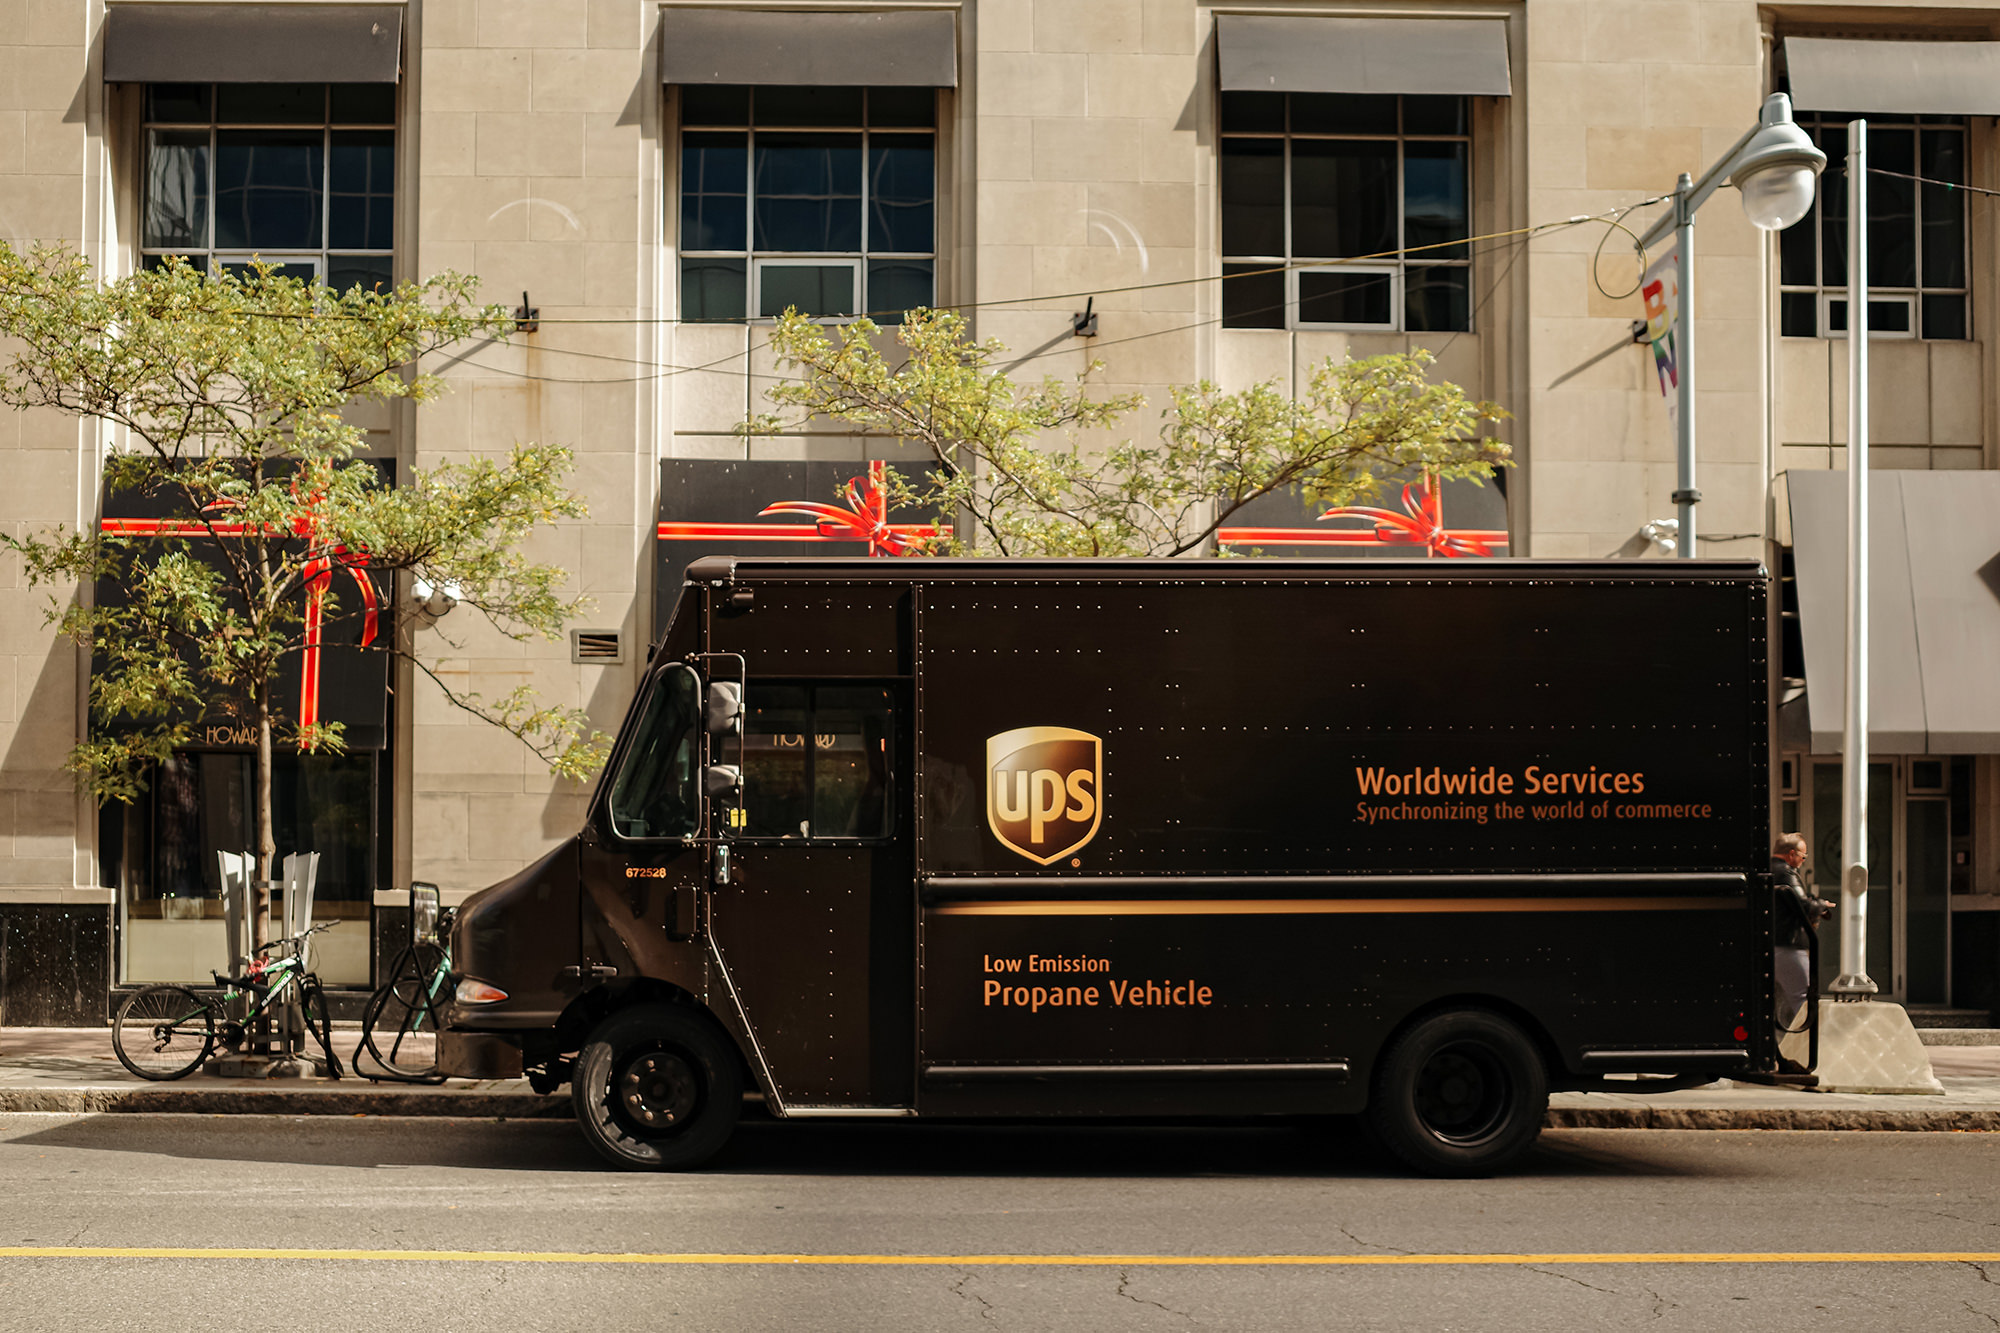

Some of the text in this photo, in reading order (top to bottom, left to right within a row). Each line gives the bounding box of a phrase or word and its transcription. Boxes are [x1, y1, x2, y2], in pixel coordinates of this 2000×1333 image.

[1356, 766, 1645, 795] Worldwide Services
[996, 769, 1095, 843] ups
[1357, 800, 1712, 825] Synchronizing the world of commerce
[625, 867, 667, 878] 672528
[984, 954, 1110, 973] Low Emission
[984, 980, 1213, 1013] Propane Vehicle
